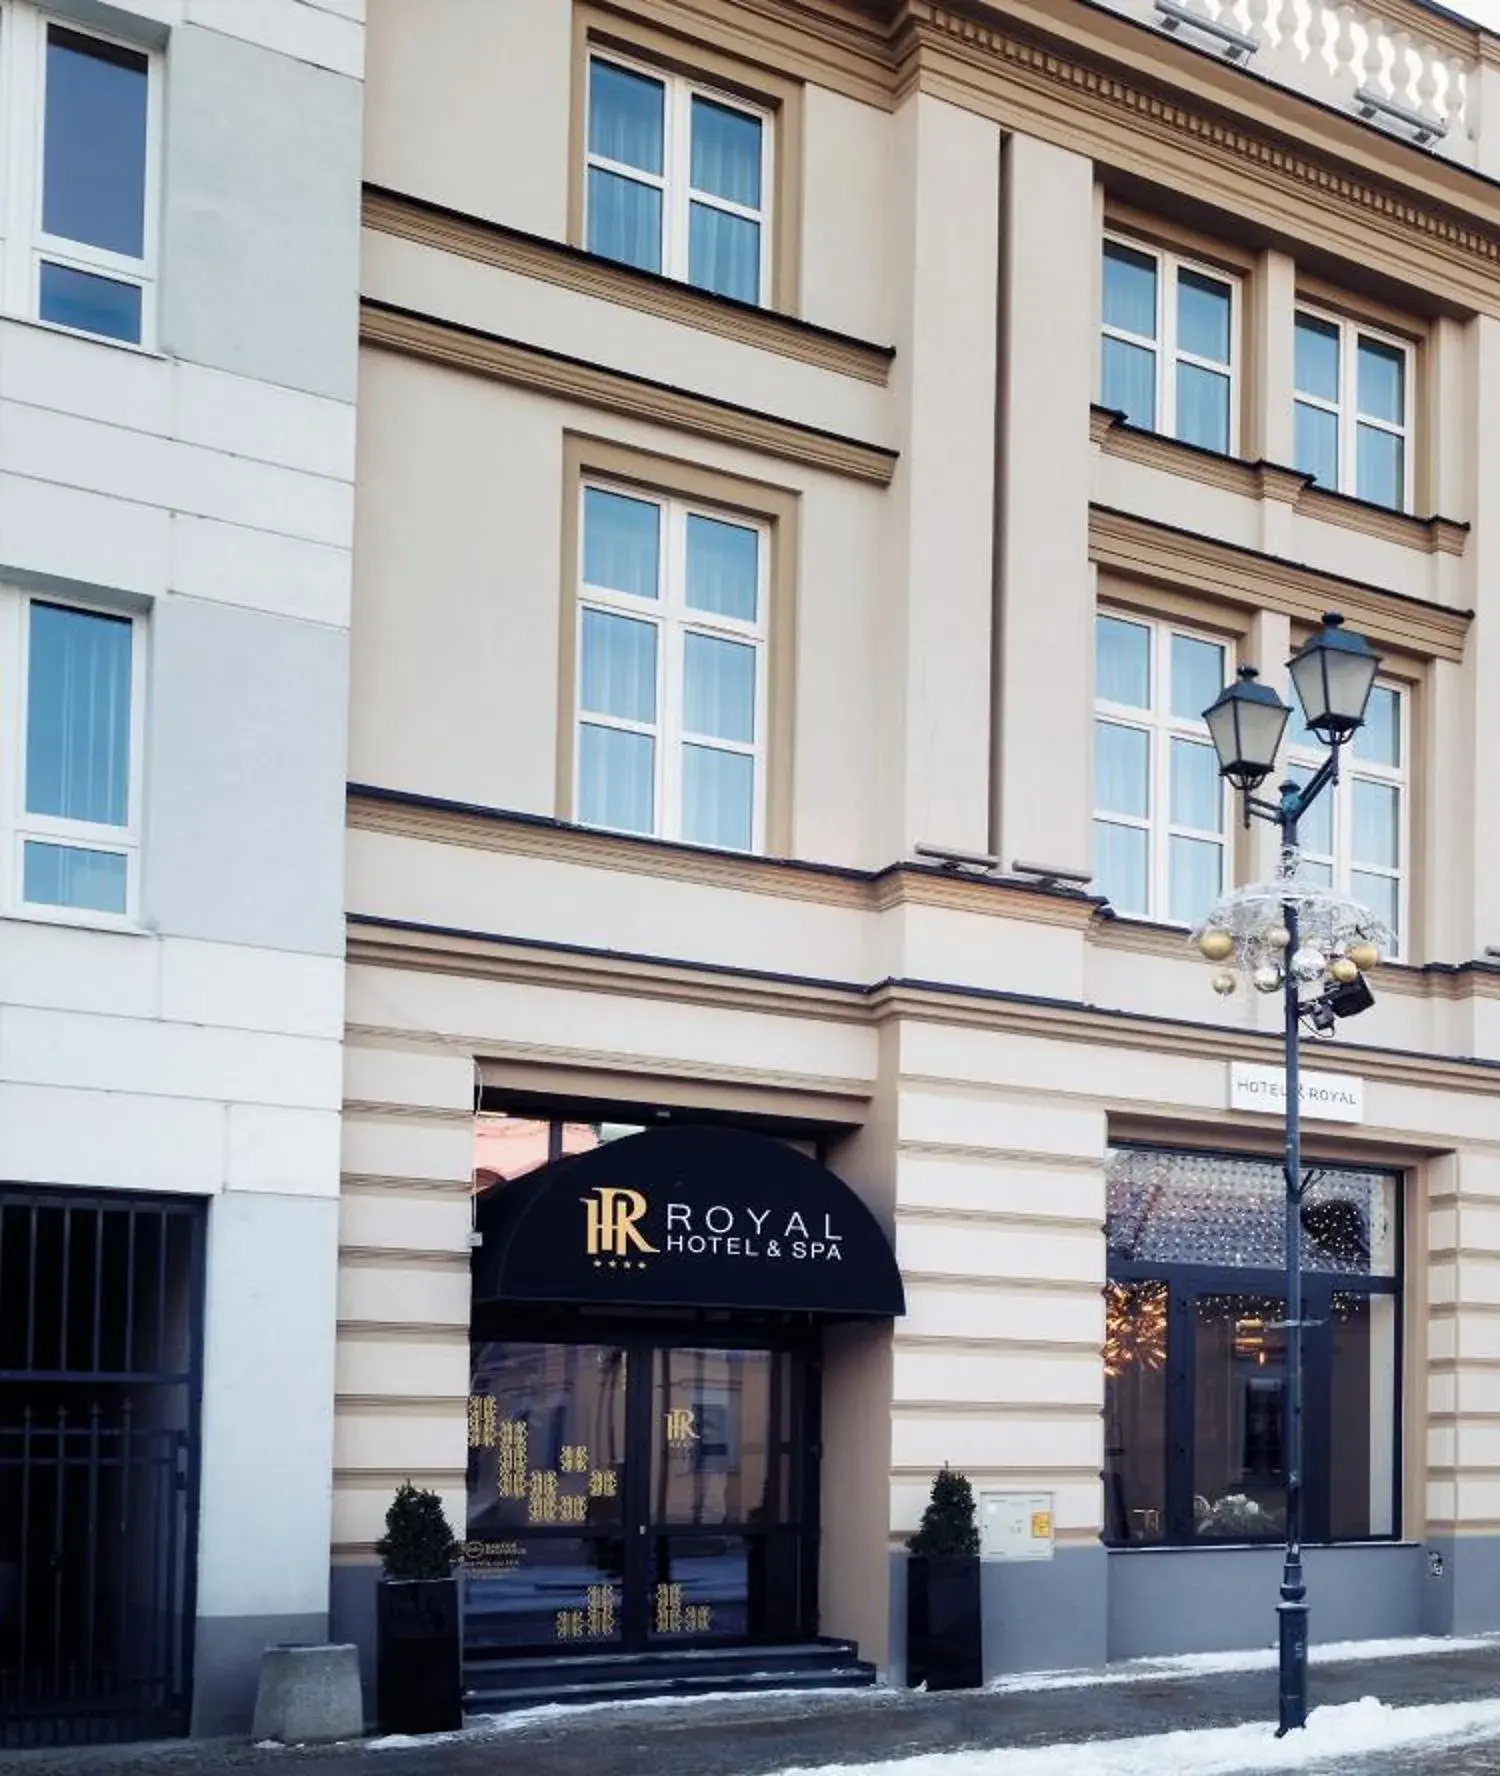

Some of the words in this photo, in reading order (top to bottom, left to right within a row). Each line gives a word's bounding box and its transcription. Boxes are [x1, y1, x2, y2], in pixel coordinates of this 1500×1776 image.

[1237, 1080, 1289, 1098] HOTEL
[1309, 1087, 1357, 1105] ROYAL
[667, 1203, 842, 1241] ROYAL
[667, 1235, 759, 1256] HOTEL
[767, 1239, 782, 1257] &
[792, 1241, 842, 1261] SPA
